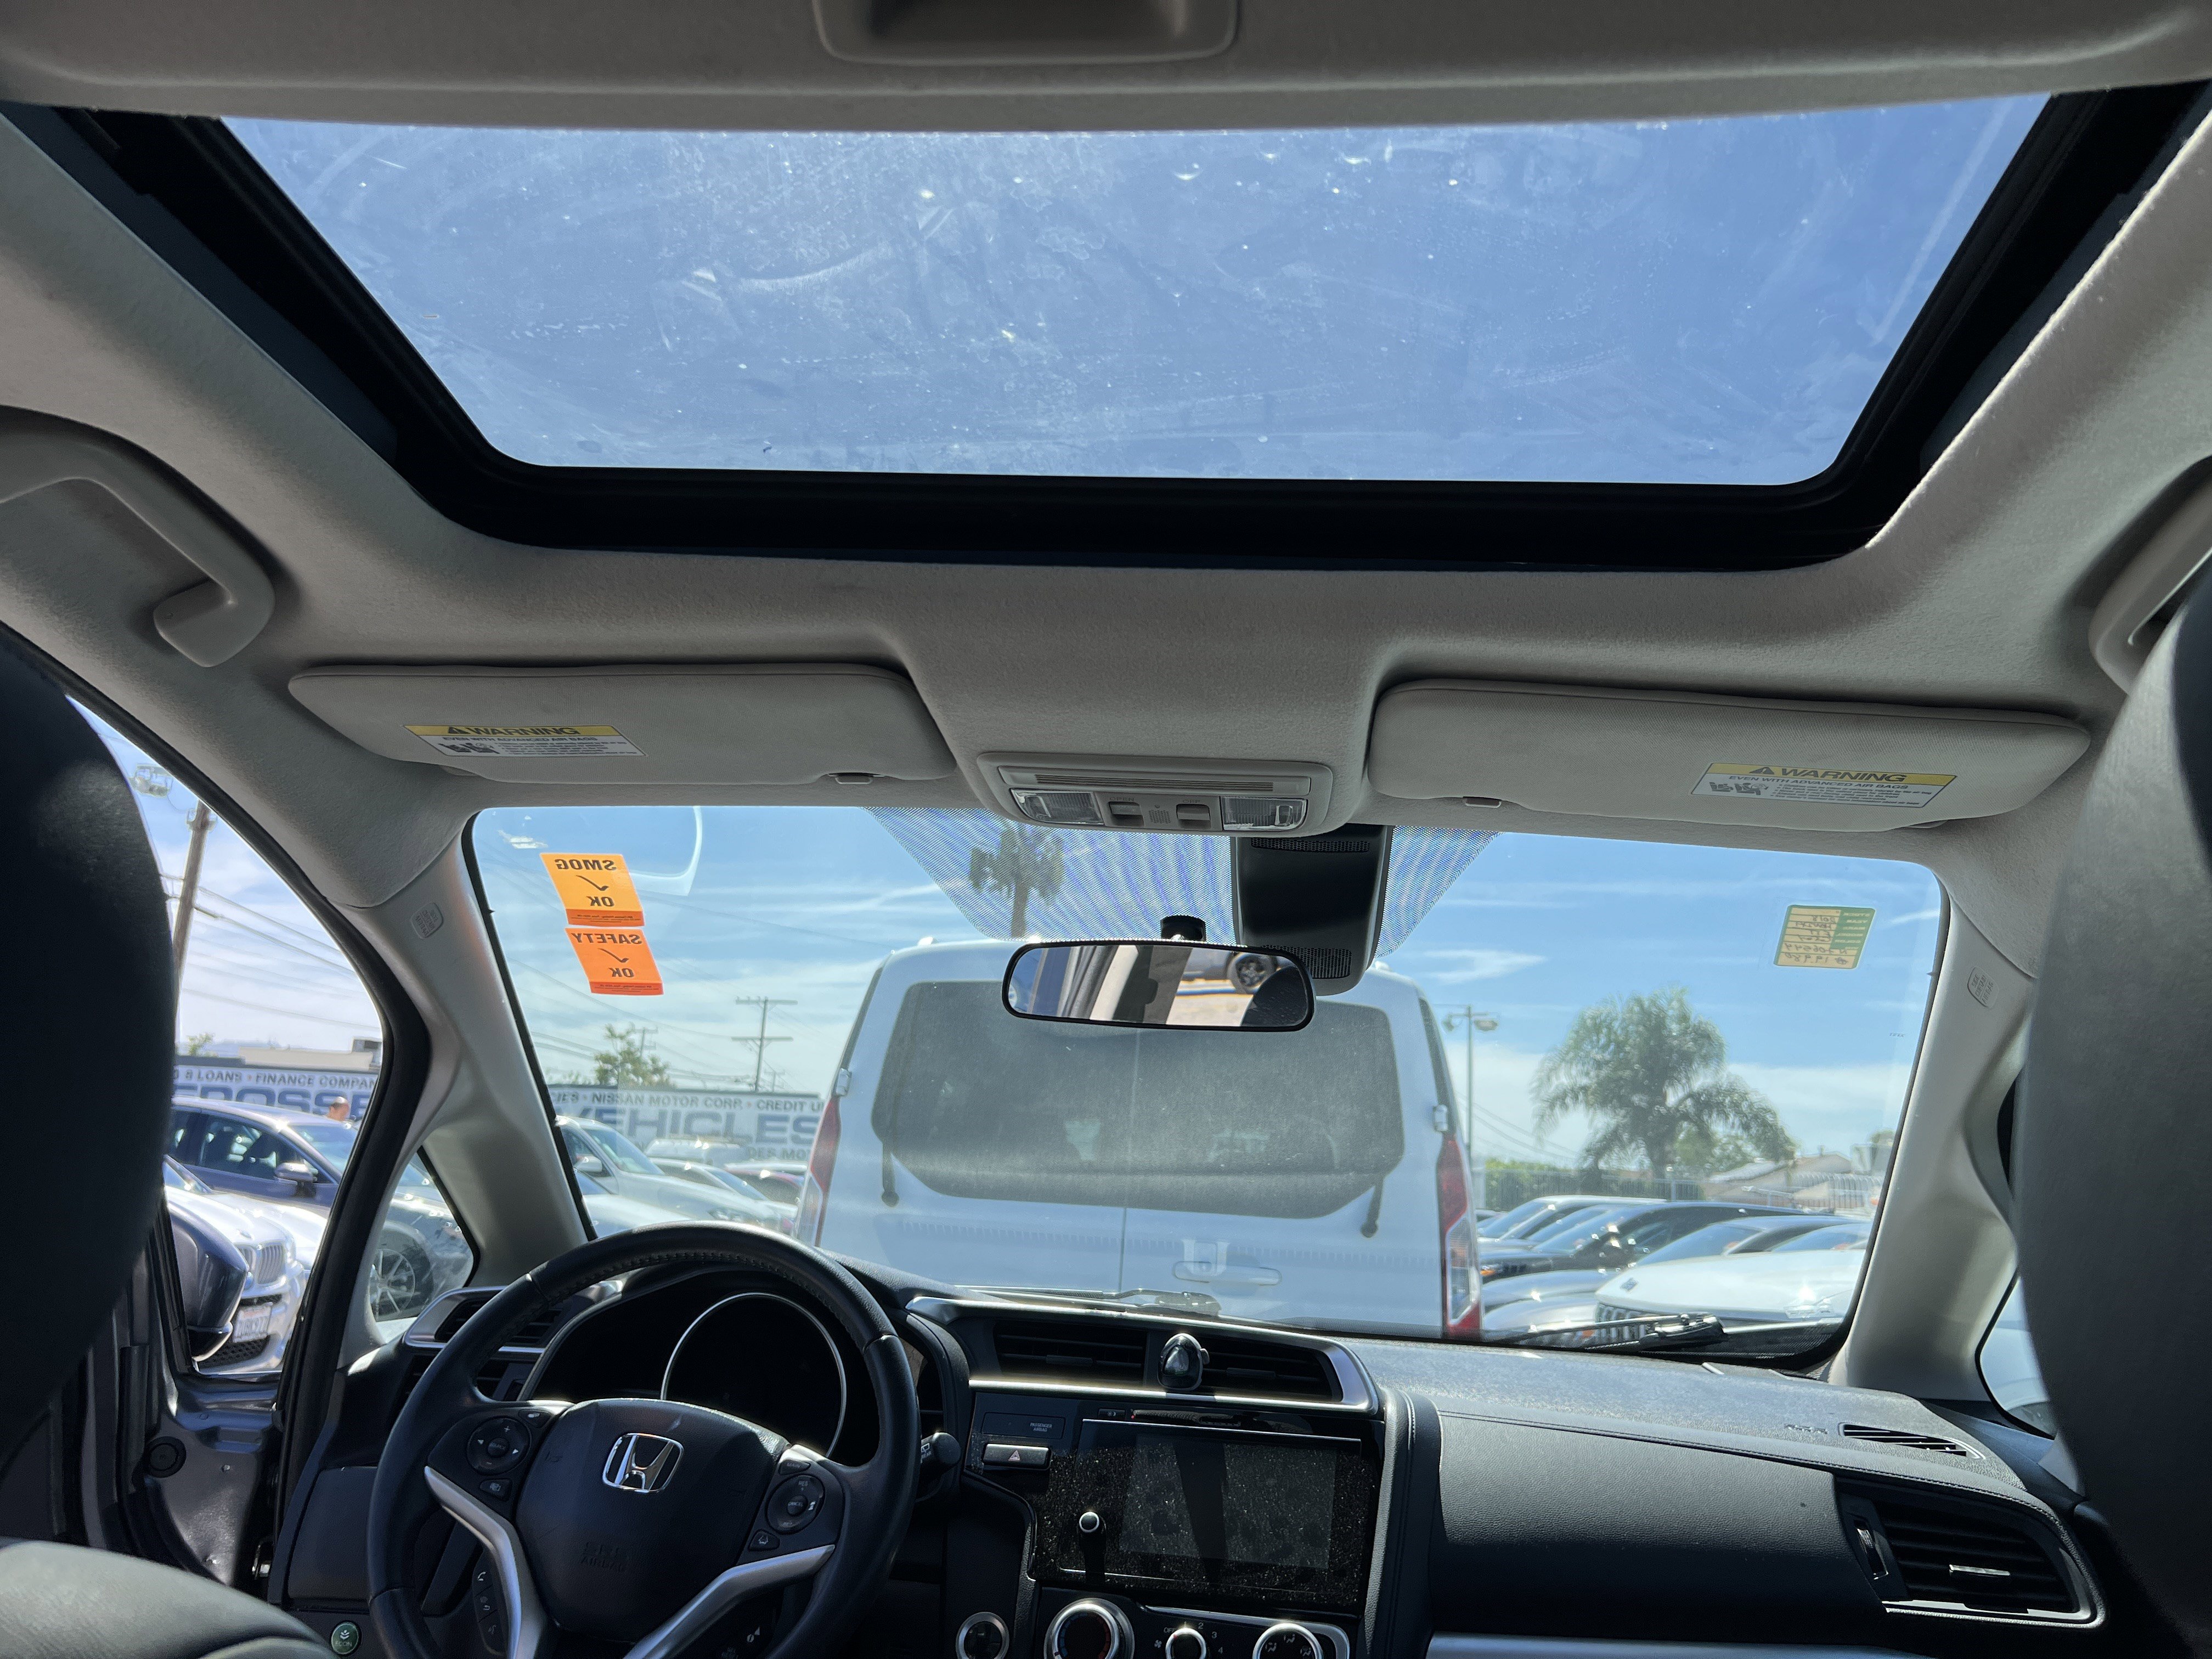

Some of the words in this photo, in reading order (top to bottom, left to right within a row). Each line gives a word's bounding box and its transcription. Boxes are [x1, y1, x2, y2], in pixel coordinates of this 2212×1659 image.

[464, 727, 580, 736] WARNING
[1781, 768, 1908, 782] WARNING
[197, 1069, 242, 1084] LOANS
[256, 1071, 314, 1087] FINANCE
[592, 1091, 644, 1104] NISSAN
[649, 1092, 699, 1108] MOTOR
[757, 1098, 807, 1112] CREDIT
